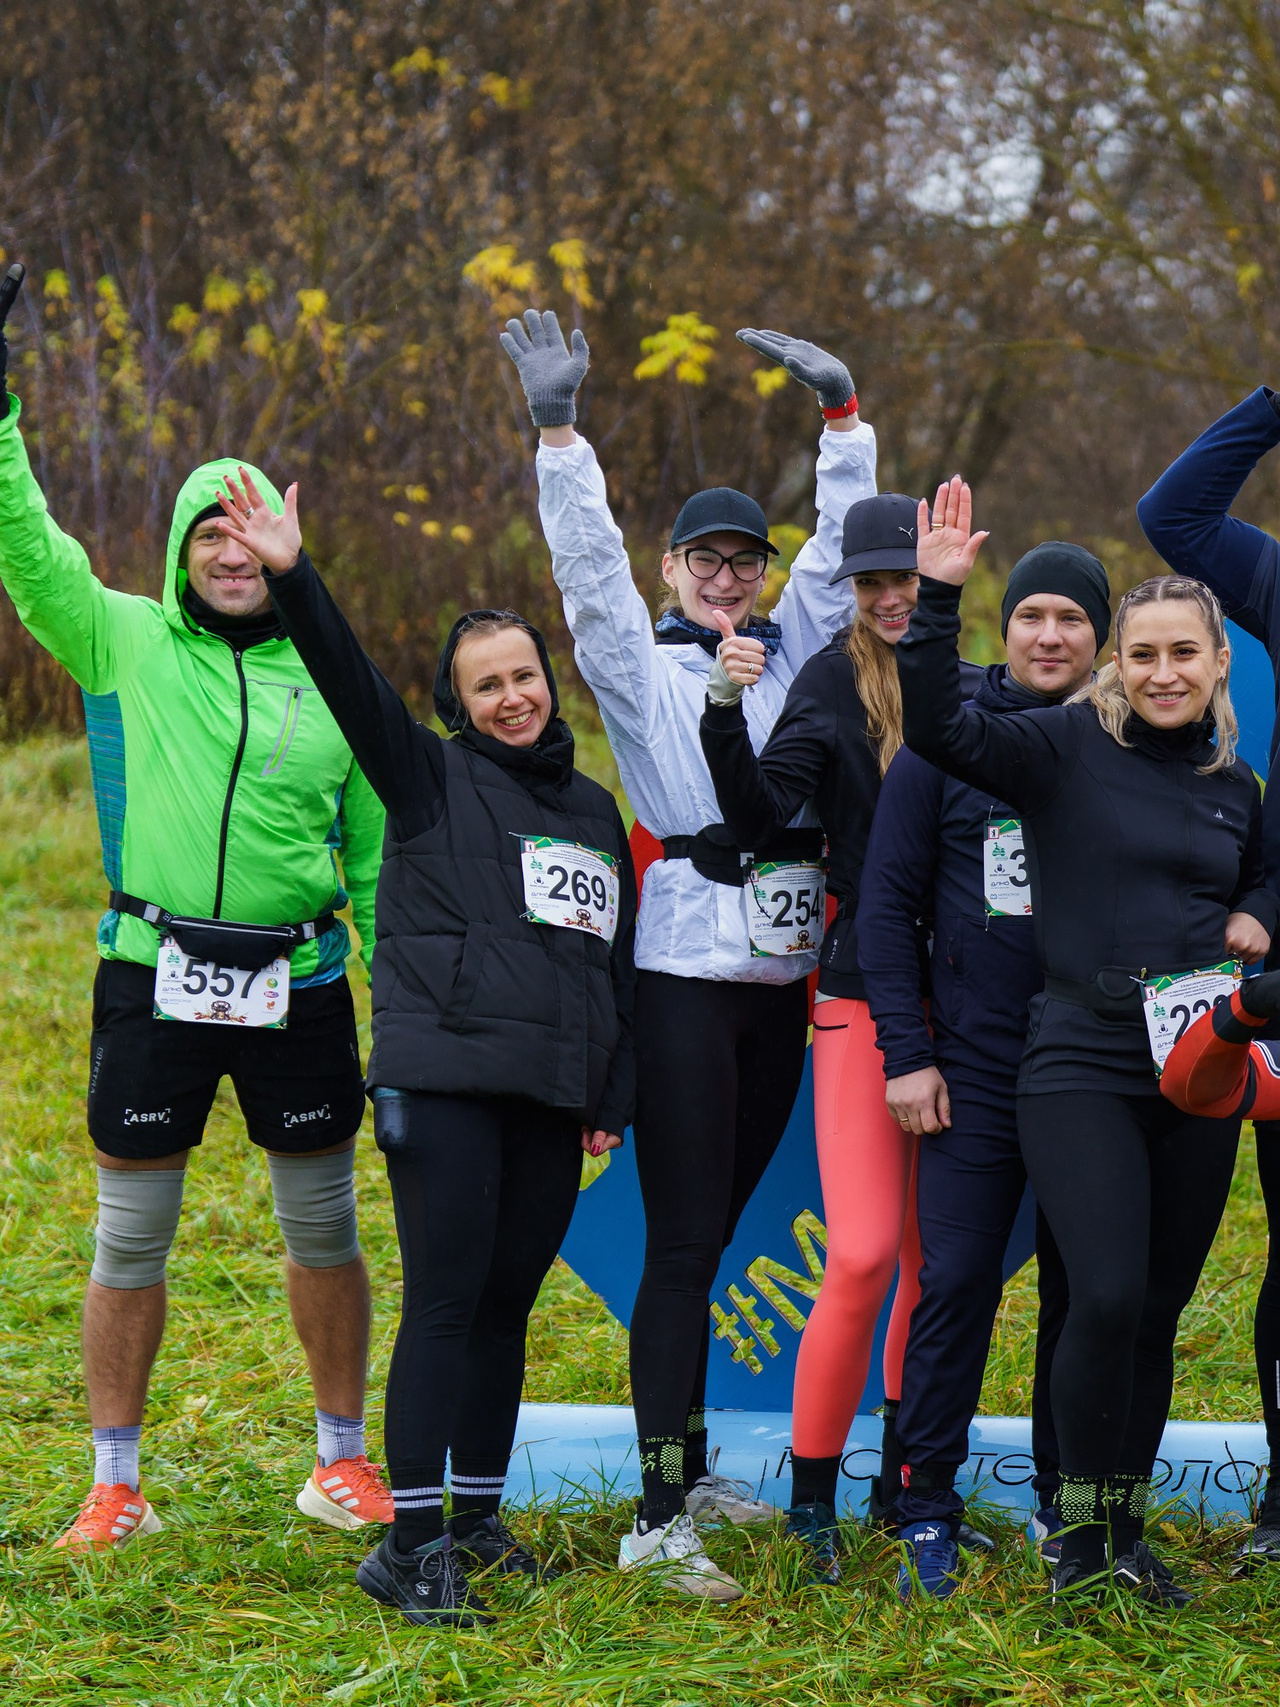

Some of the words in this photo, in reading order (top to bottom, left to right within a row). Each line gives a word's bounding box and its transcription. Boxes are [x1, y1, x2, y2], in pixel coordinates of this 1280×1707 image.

[546, 865, 607, 912] 269
[770, 886, 820, 929] 254
[182, 958, 262, 999] 557
[129, 1111, 166, 1123] ASRV
[289, 1108, 325, 1124] ASRV
[914, 1532, 936, 1543] PUMA
